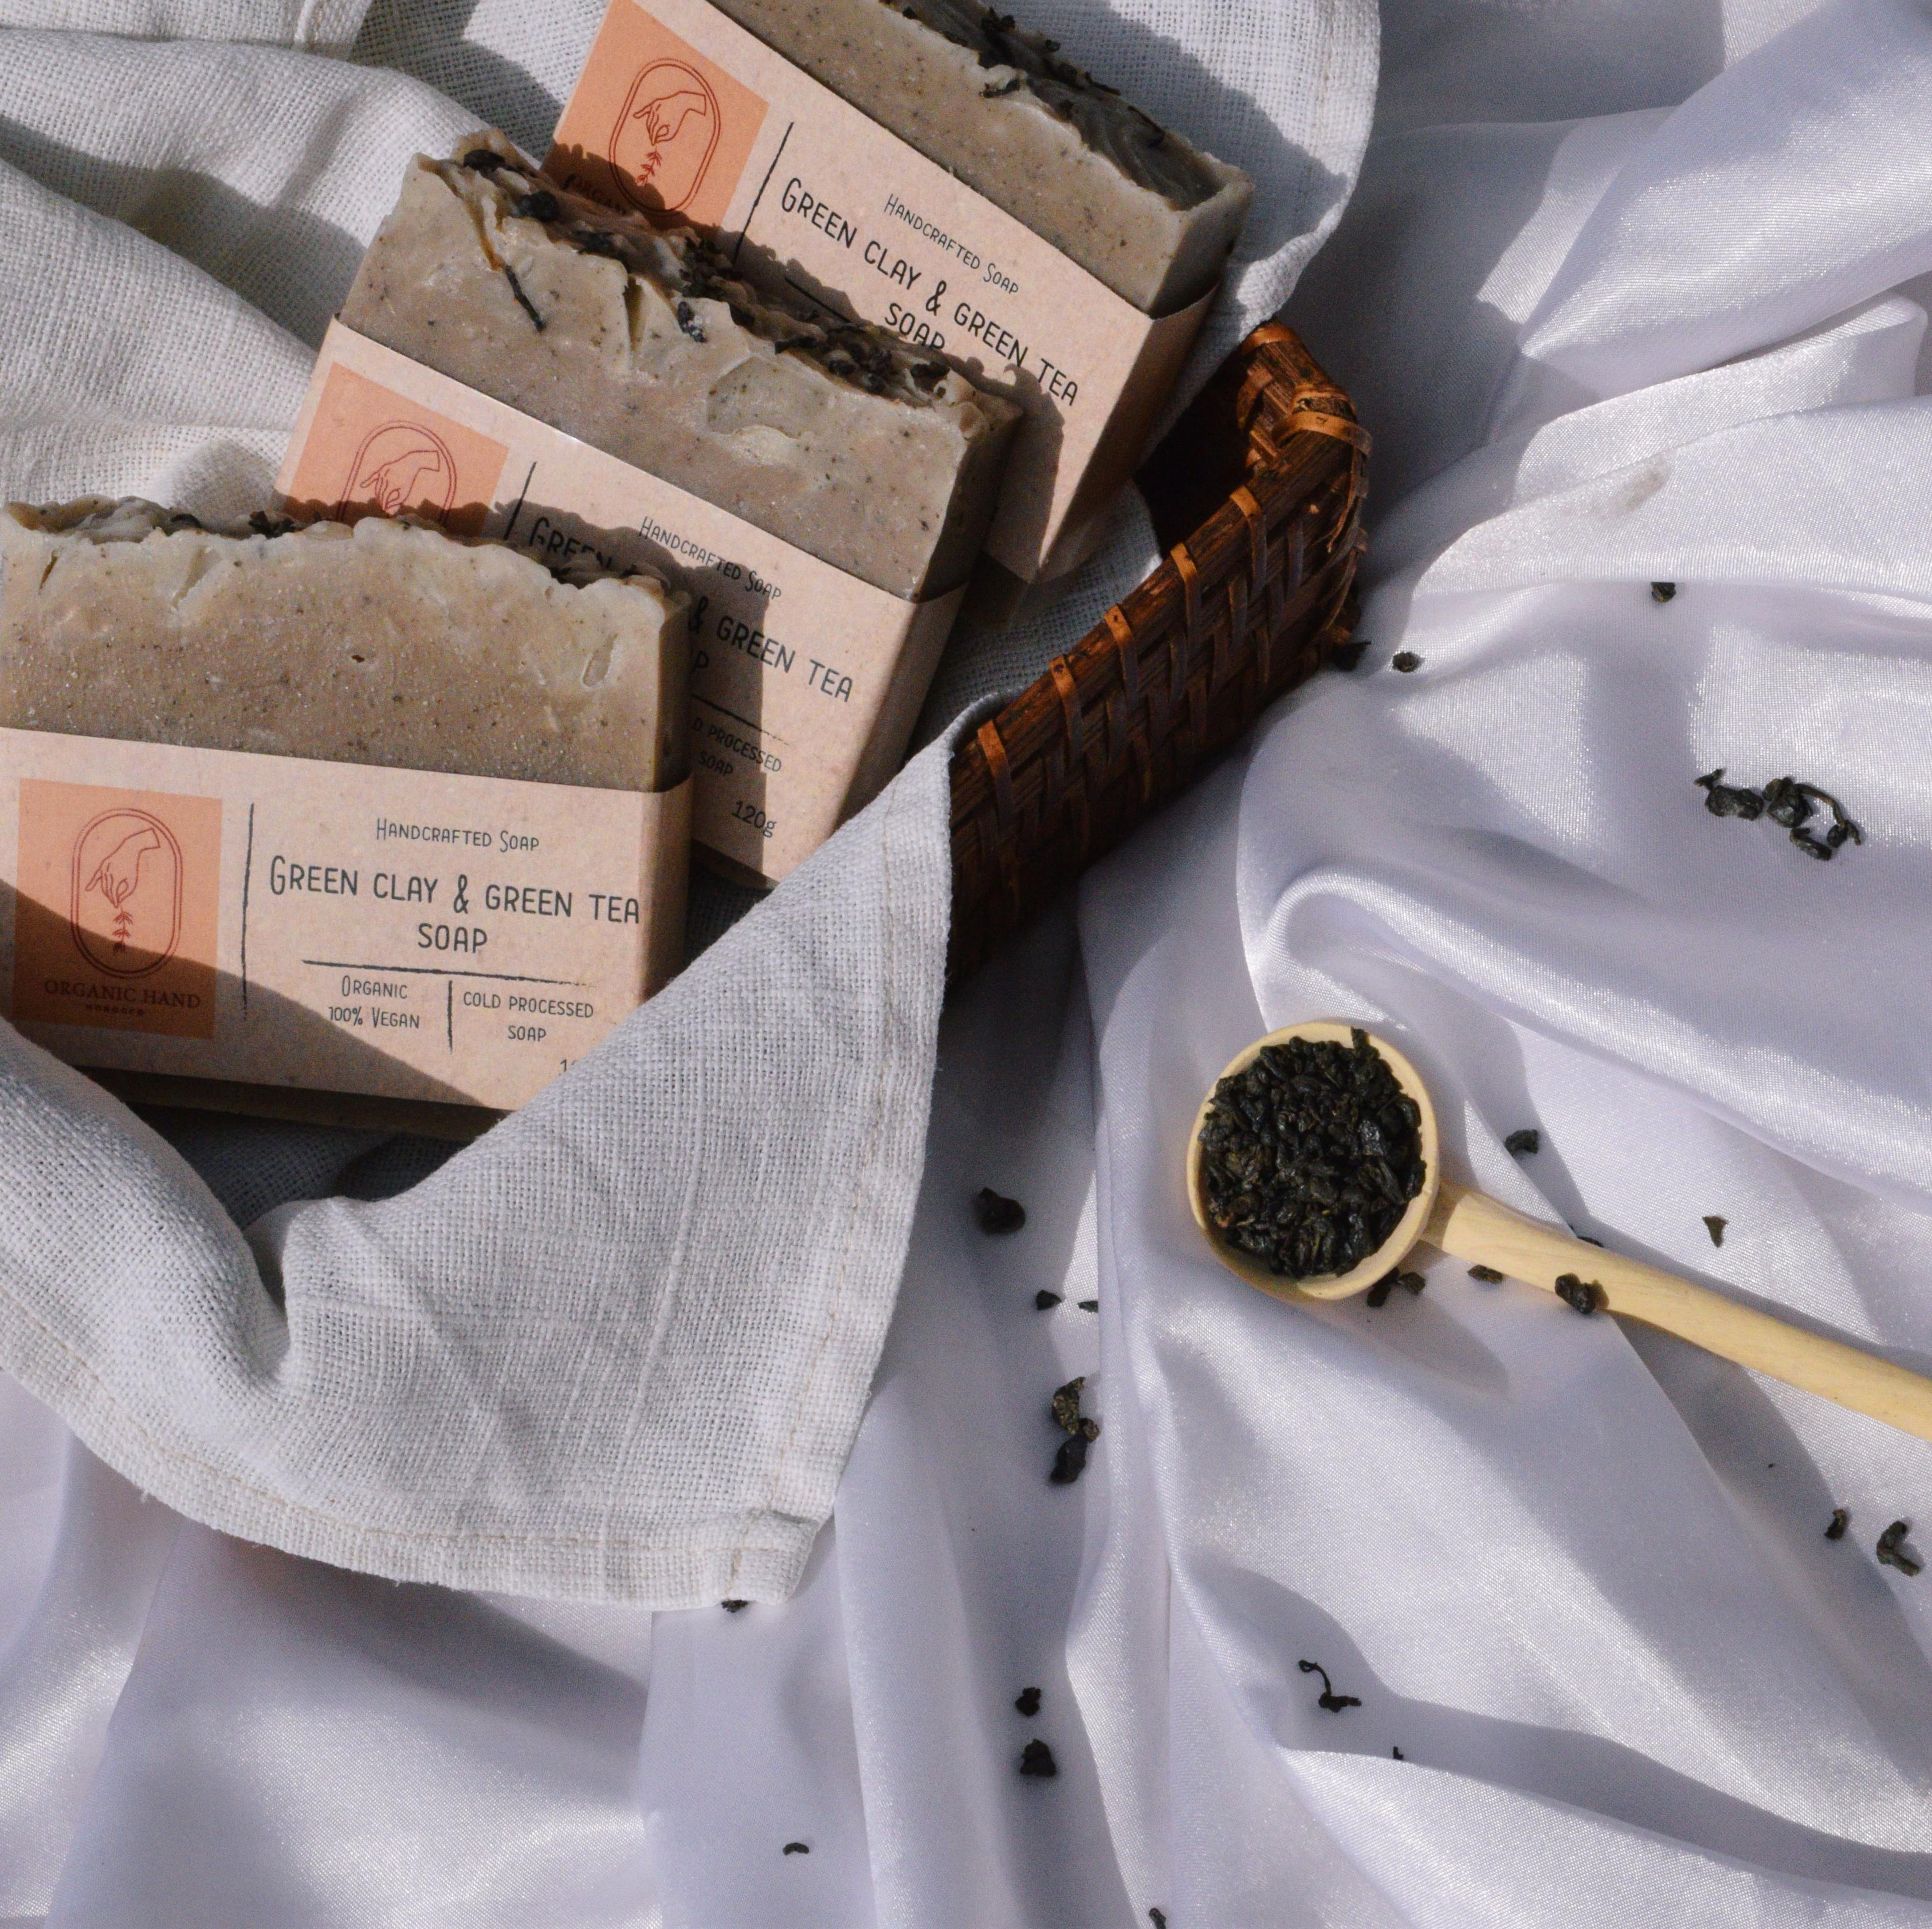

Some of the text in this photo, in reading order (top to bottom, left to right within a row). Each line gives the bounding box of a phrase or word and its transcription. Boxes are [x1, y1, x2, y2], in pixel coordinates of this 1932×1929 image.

[883, 194, 1018, 294] HANDCRAFTED SOAP
[781, 178, 1079, 406] GREEN CLAY & GREEN TEA
[884, 303, 945, 350] SOAP
[638, 516, 781, 600] HANDCRAFTED SOAP
[688, 595, 709, 635] &
[717, 616, 795, 673] GREEN
[809, 659, 852, 703] TEA
[698, 751, 734, 777] SOAP
[708, 722, 782, 773] PROCESSED
[376, 818, 539, 852] HANDCRAFTED SOAP
[731, 799, 777, 838] 120g
[270, 855, 639, 924] GREEN CLAY & GREEN TEA
[418, 923, 488, 953] SOAP
[44, 980, 200, 1009] ORGANIC HAND
[342, 975, 408, 999] ORGANIC
[463, 992, 594, 1018] COLD PROCESSED
[329, 1006, 420, 1029] 100% VEGAN
[508, 1025, 546, 1042] SOAP
